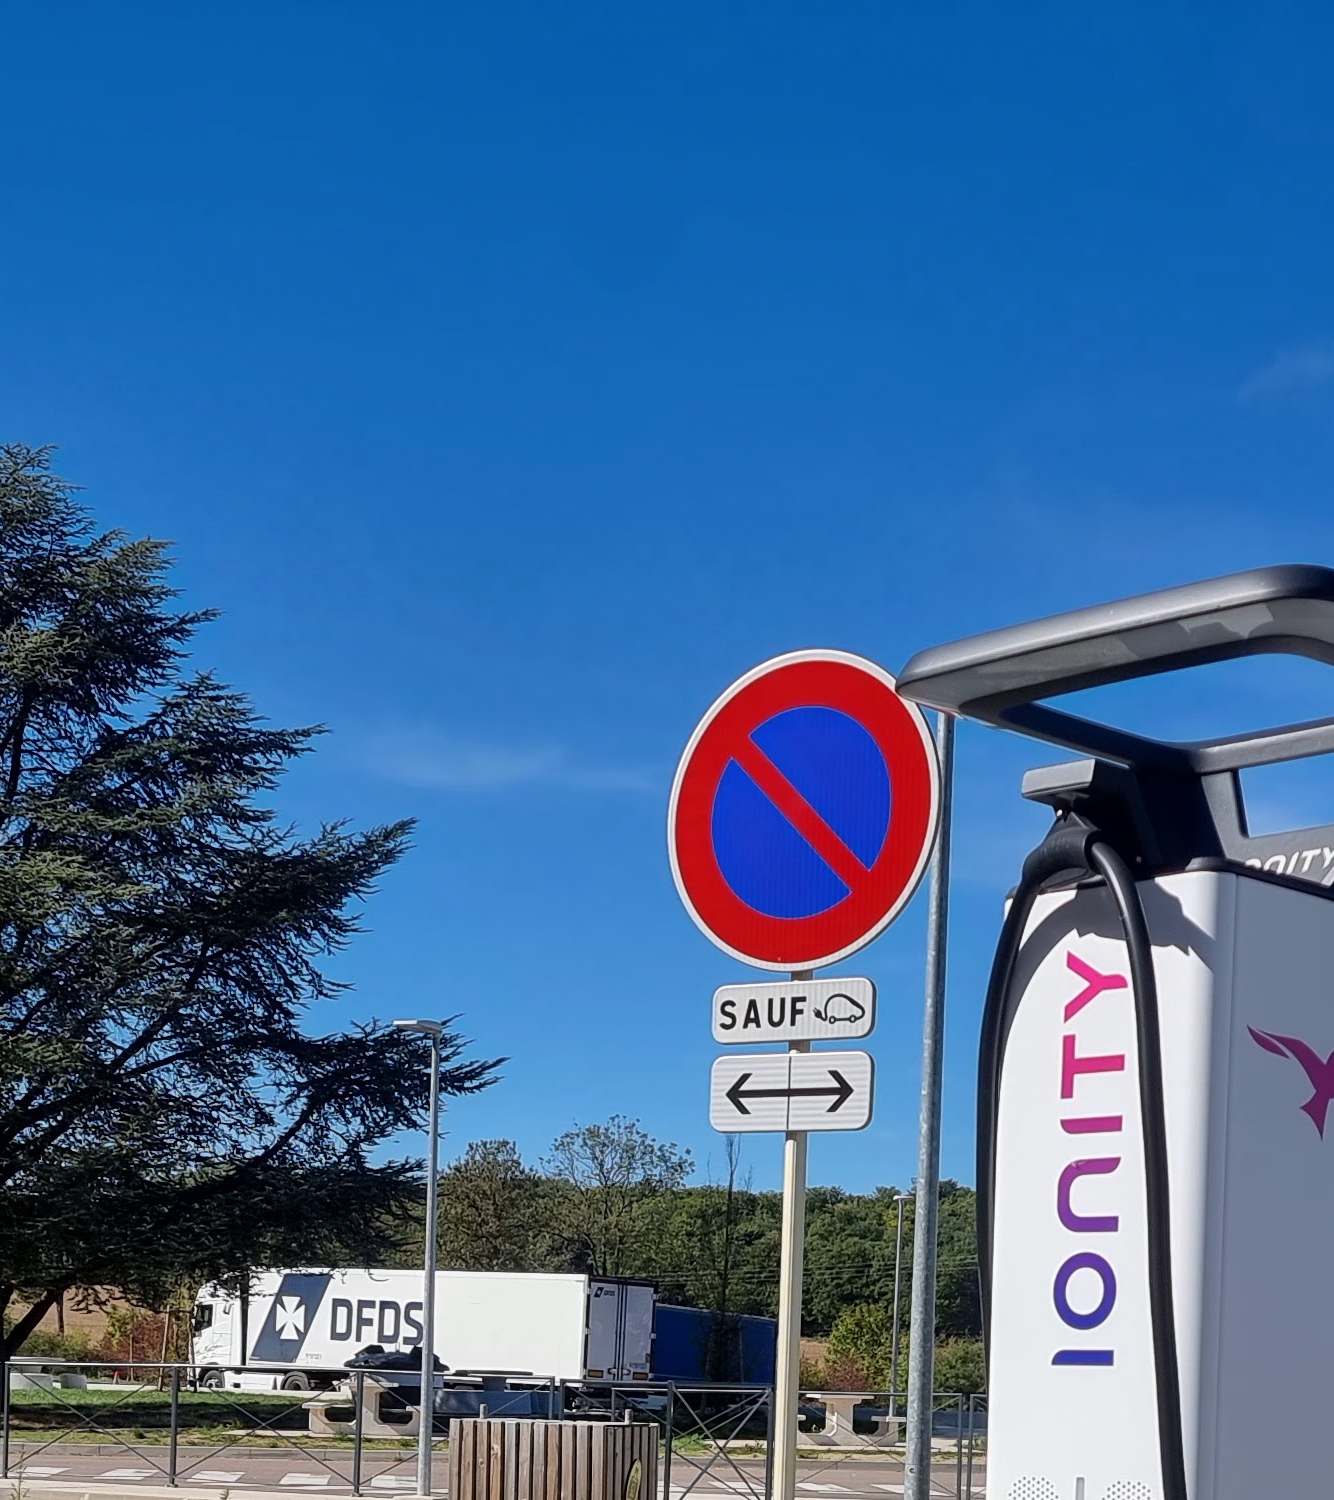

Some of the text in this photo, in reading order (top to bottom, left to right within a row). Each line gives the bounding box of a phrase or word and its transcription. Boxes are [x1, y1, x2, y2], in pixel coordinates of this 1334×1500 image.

[719, 995, 807, 1031] SAUF
[1052, 951, 1128, 1366] IONITY
[330, 1298, 424, 1346] DFDS
